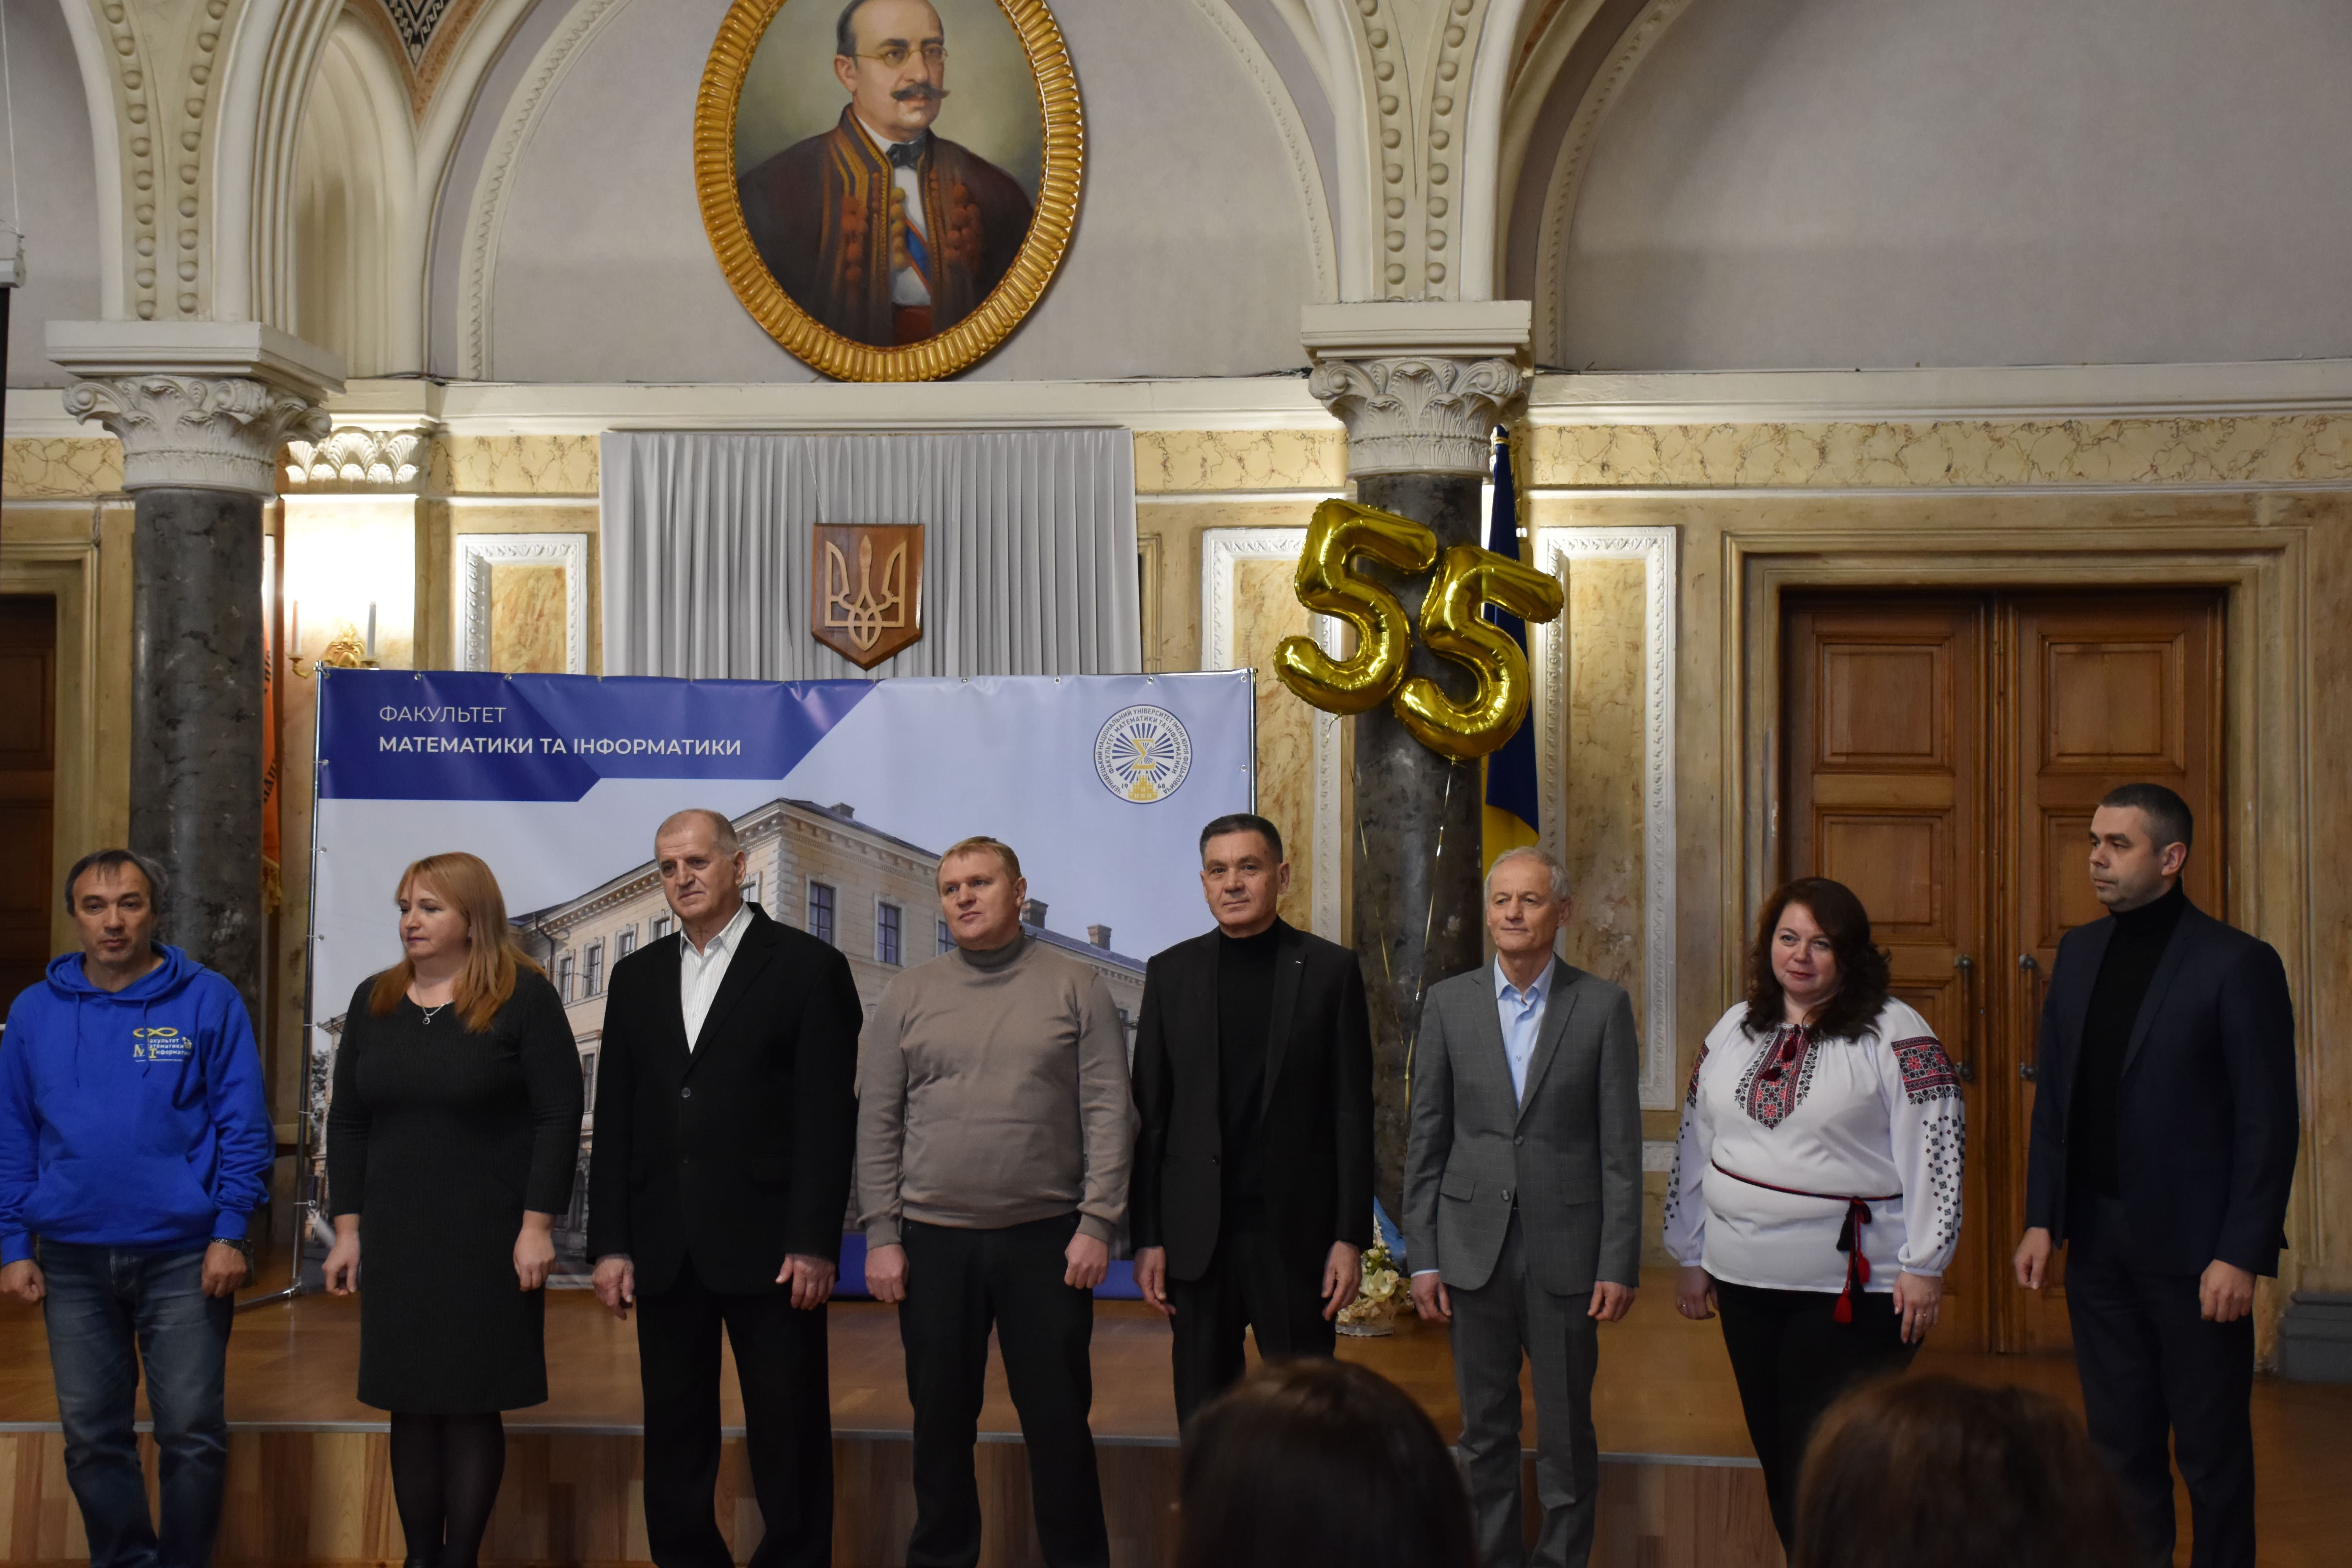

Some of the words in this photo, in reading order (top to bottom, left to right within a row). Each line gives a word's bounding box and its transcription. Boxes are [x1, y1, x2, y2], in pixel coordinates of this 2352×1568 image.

[1274, 498, 1564, 760] 55
[380, 706, 506, 722] ФАКУЛЬТЕТ
[1098, 709, 1132, 749] НАЦІОНАЛЬНИЙ
[1133, 708, 1174, 723] УНІВЕРСИТЕТ
[1172, 721, 1185, 739] ІМЕНІ
[379, 736, 532, 753] МАТЕМАТИКИ
[540, 739, 566, 754] ТА
[574, 738, 740, 755] ІНФОРМАТИКИ
[1104, 734, 1115, 774] ФАКУЛЬТЕТ
[1114, 715, 1158, 733] МАТЕМАТИКИ
[1159, 720, 1166, 728] ТА
[1166, 726, 1181, 774] ІНФОРМАТИКИ
[1096, 752, 1121, 794] ЧЕРНІВЕЦЬКИЙ
[1163, 755, 1189, 794] ФЕДЬКОВИЧА
